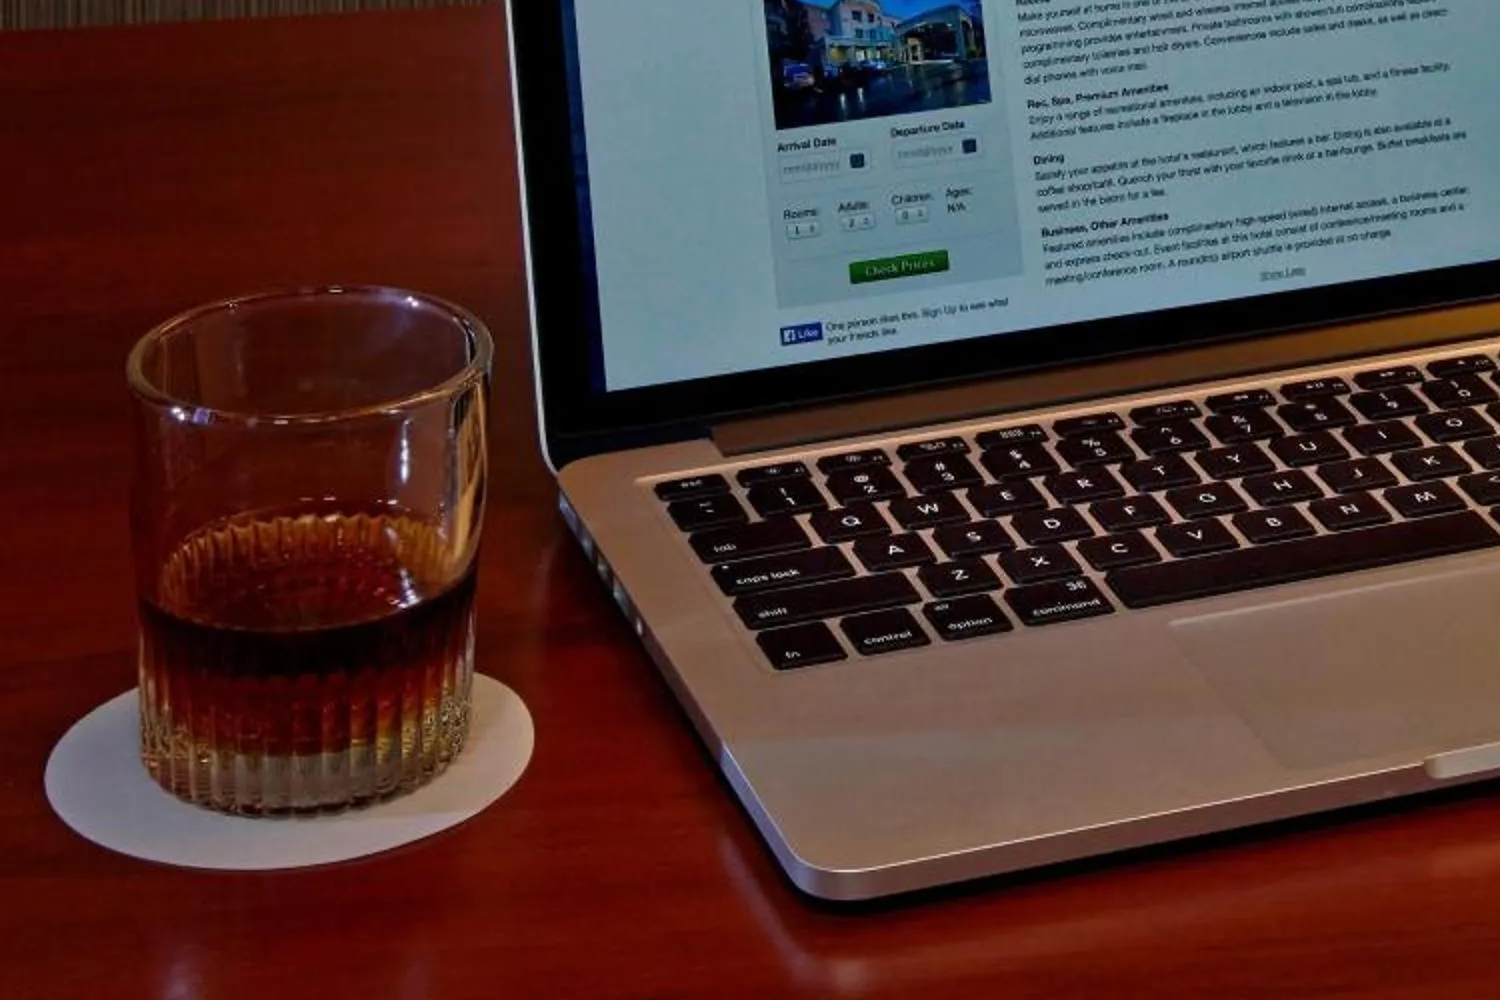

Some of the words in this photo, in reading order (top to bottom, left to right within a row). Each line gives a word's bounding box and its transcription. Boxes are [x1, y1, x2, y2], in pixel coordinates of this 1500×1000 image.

[1075, 88, 1118, 103] Premium
[1121, 82, 1168, 97] Amenities
[891, 123, 939, 139] Departure
[941, 120, 965, 131] Date
[777, 139, 810, 152] Arrival
[813, 136, 836, 147] Date
[1033, 152, 1064, 166] Dining
[1090, 219, 1118, 230] Other
[1120, 212, 1168, 227] Amenities
[865, 263, 897, 277] Check
[900, 257, 935, 272] Prices
[847, 316, 877, 330] person
[797, 327, 819, 339] Like
[1445, 418, 1462, 427] O
[1299, 442, 1317, 452] U
[1227, 453, 1240, 464] Y
[1422, 456, 1441, 466] K
[1152, 465, 1165, 476] T
[1353, 468, 1363, 478] J
[1076, 478, 1093, 489] R
[1273, 479, 1292, 491] H
[1000, 491, 1014, 501] E
[1415, 491, 1436, 503] M
[917, 503, 939, 514] W
[1124, 505, 1136, 515] F
[1340, 504, 1360, 515] N
[841, 516, 862, 526] Q
[1043, 518, 1060, 529] D
[1265, 517, 1282, 527] B
[966, 531, 981, 542] S
[1186, 529, 1201, 540] V
[889, 545, 904, 554] A
[1111, 542, 1129, 553] C
[1030, 555, 1050, 567] X
[736, 573, 768, 585] caps
[770, 568, 800, 579] lock
[951, 569, 969, 581] Z
[757, 606, 788, 618] shift
[1032, 598, 1101, 617] command
[947, 616, 993, 630] option
[863, 631, 912, 645] control
